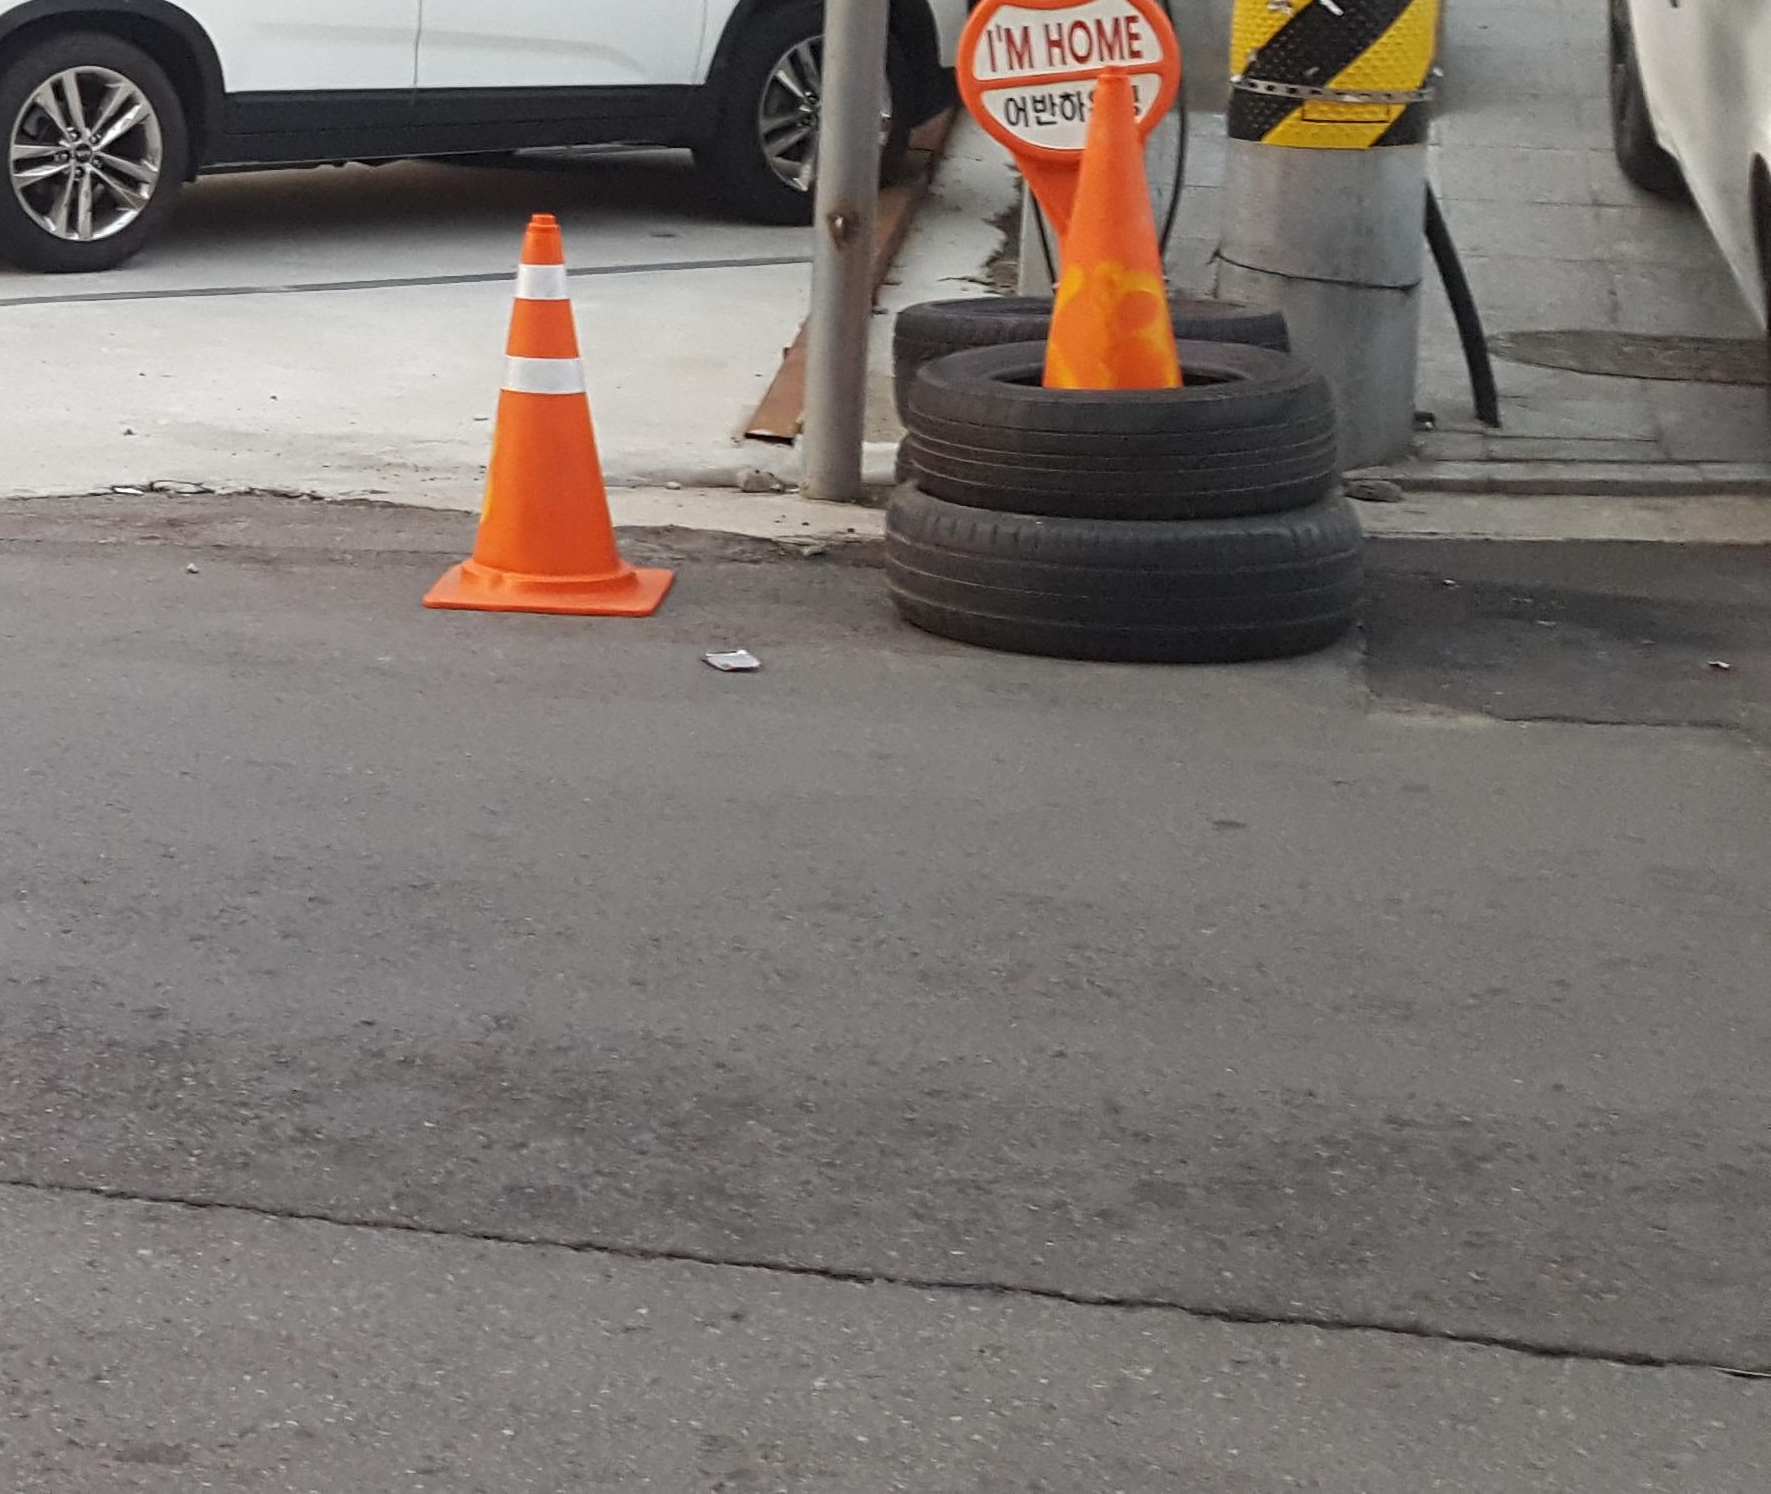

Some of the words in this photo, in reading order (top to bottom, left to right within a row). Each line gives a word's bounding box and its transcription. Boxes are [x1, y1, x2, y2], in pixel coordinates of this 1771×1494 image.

[987, 23, 1035, 73] I'M
[1043, 15, 1144, 67] HOME
[1003, 85, 1141, 128] 어반하
